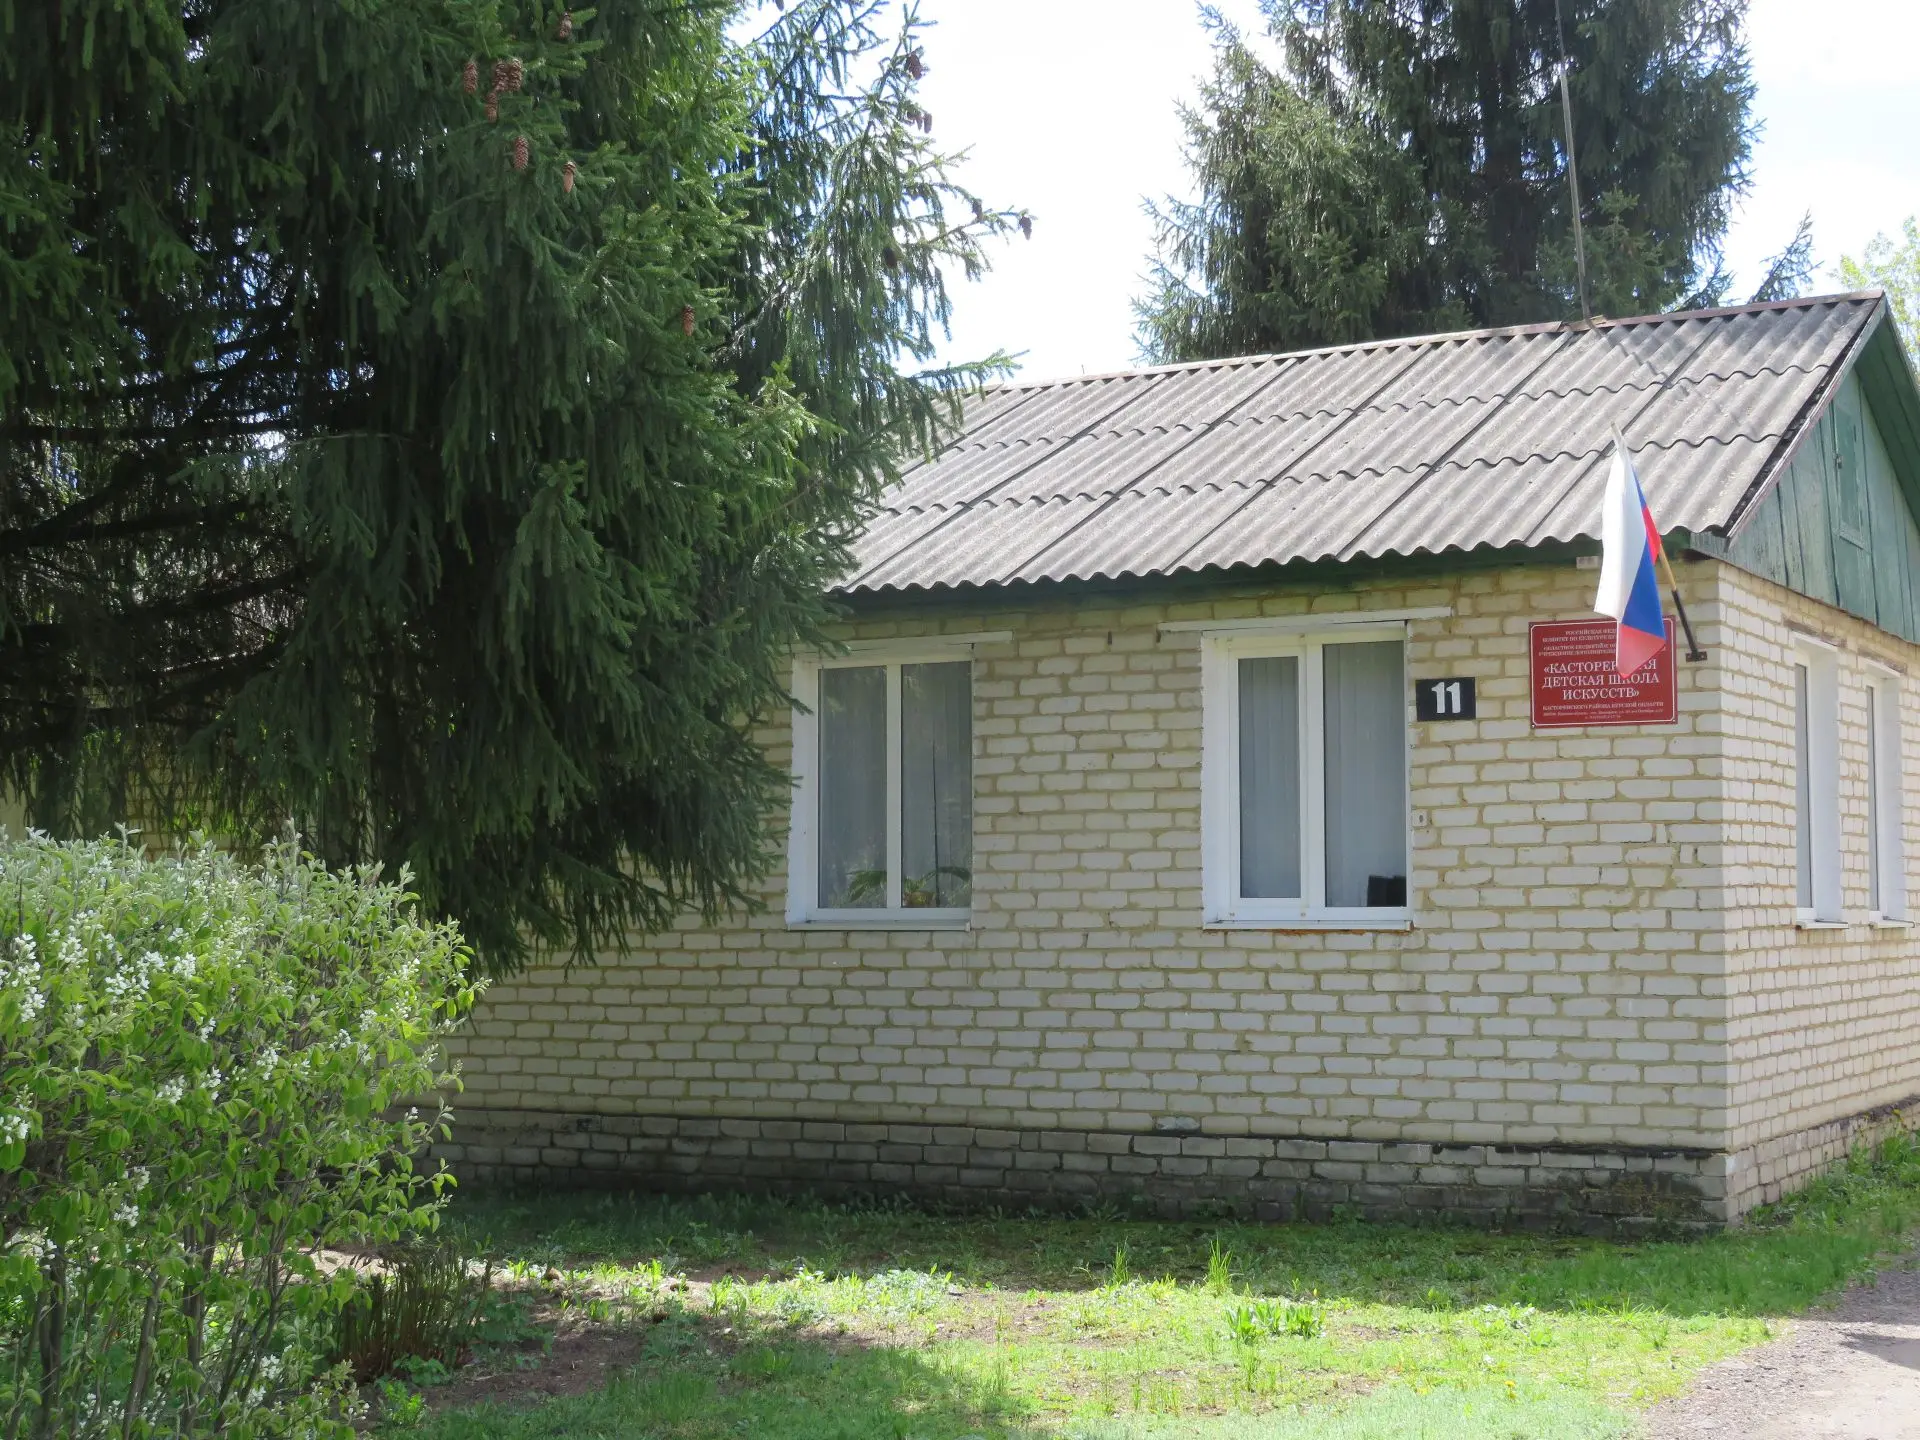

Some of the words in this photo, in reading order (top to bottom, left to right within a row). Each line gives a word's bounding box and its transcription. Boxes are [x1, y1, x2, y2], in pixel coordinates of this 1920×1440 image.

[1542, 674, 1604, 689] ДЕТСКАЯ
[1431, 681, 1461, 714] 11
[1563, 687, 1640, 700] ИСКУССТВ»
